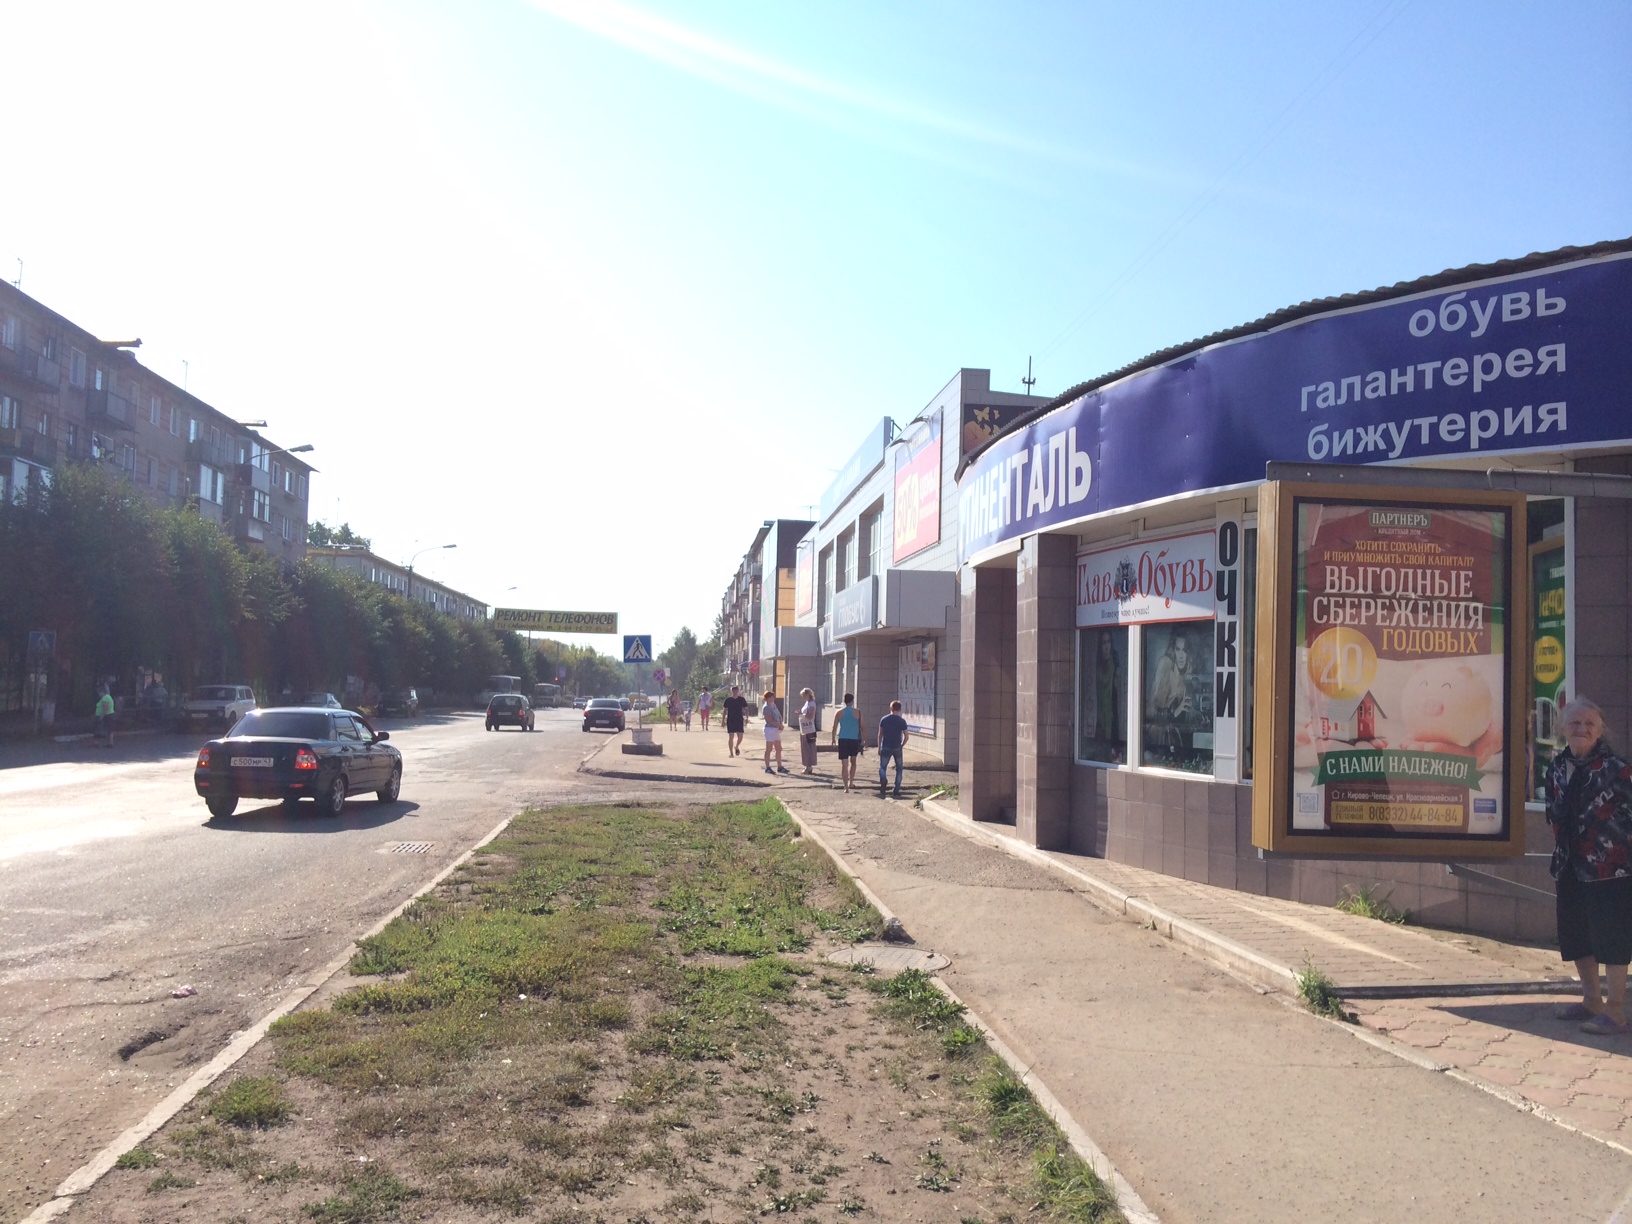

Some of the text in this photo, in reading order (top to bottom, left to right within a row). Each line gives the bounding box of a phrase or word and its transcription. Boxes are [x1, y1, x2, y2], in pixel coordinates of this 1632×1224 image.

[1408, 287, 1567, 338] обувь
[1300, 343, 1566, 412] галантерея
[1307, 401, 1567, 461] бижутерия
[1372, 512, 1428, 527] ПАРТНЕРЪ
[1324, 551, 1475, 568] И ПРИУМНОЖИТЬ СВОЙ КАПИТАЛ?
[1355, 540, 1442, 554] ХОТИТЕ СОХРАНИТЬ
[1077, 547, 1214, 609] Глав Обувь
[1324, 565, 1473, 600] ВЫГОДНЫЕ
[496, 610, 614, 625] РЕМОНТ ТЕЛЕФОНОВ
[1215, 521, 1239, 718] ОЧКИ
[1313, 596, 1484, 630] СБЕРЕЖЕНИЯ
[1320, 641, 1363, 685] 20
[1326, 756, 1468, 780] С НАМИ НАДЕЖНО!
[1368, 805, 1458, 823] 8(8332) 44-84-84
